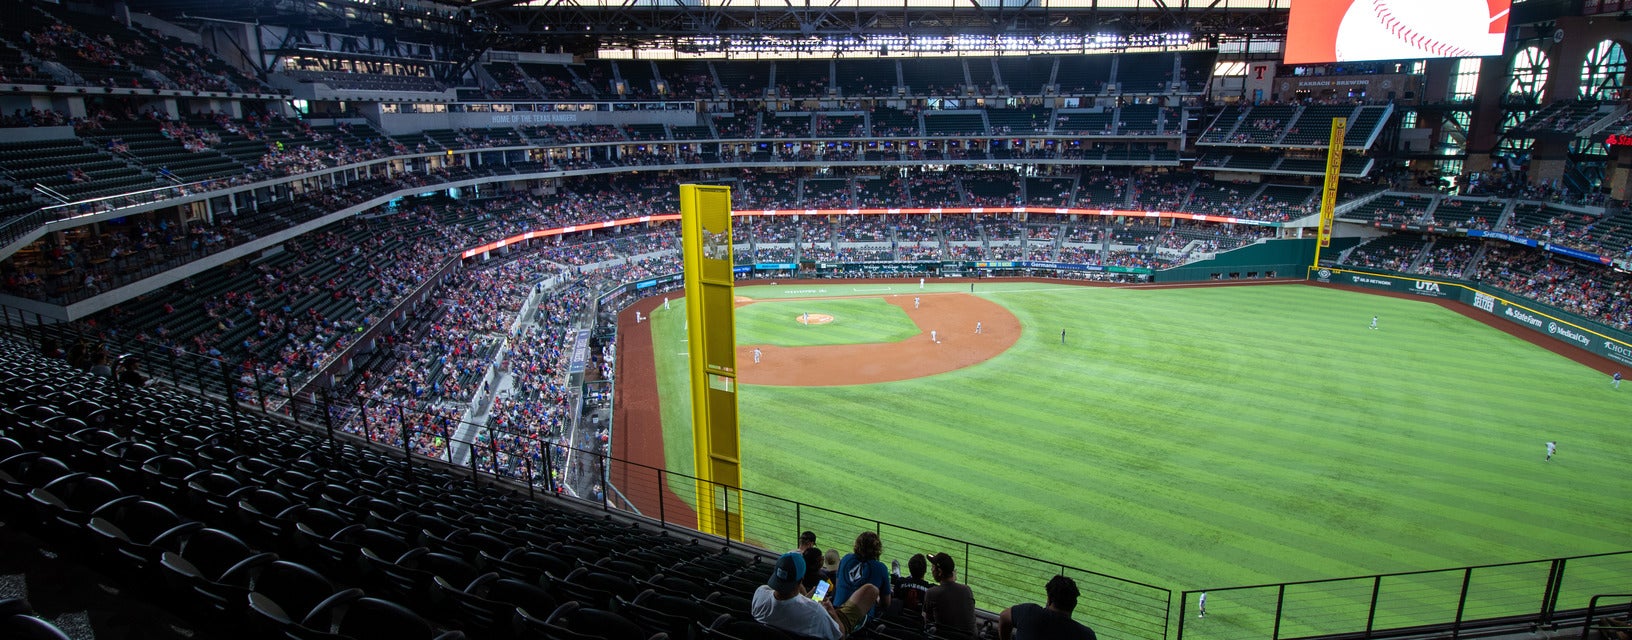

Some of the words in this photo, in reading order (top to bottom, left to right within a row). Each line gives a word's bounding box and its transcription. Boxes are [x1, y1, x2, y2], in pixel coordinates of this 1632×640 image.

[1254, 66, 1266, 80] T
[492, 115, 510, 123] HOME
[1416, 280, 1440, 292] UTA
[1473, 296, 1494, 313] SELTZER
[1608, 342, 1632, 357] CHOCT
